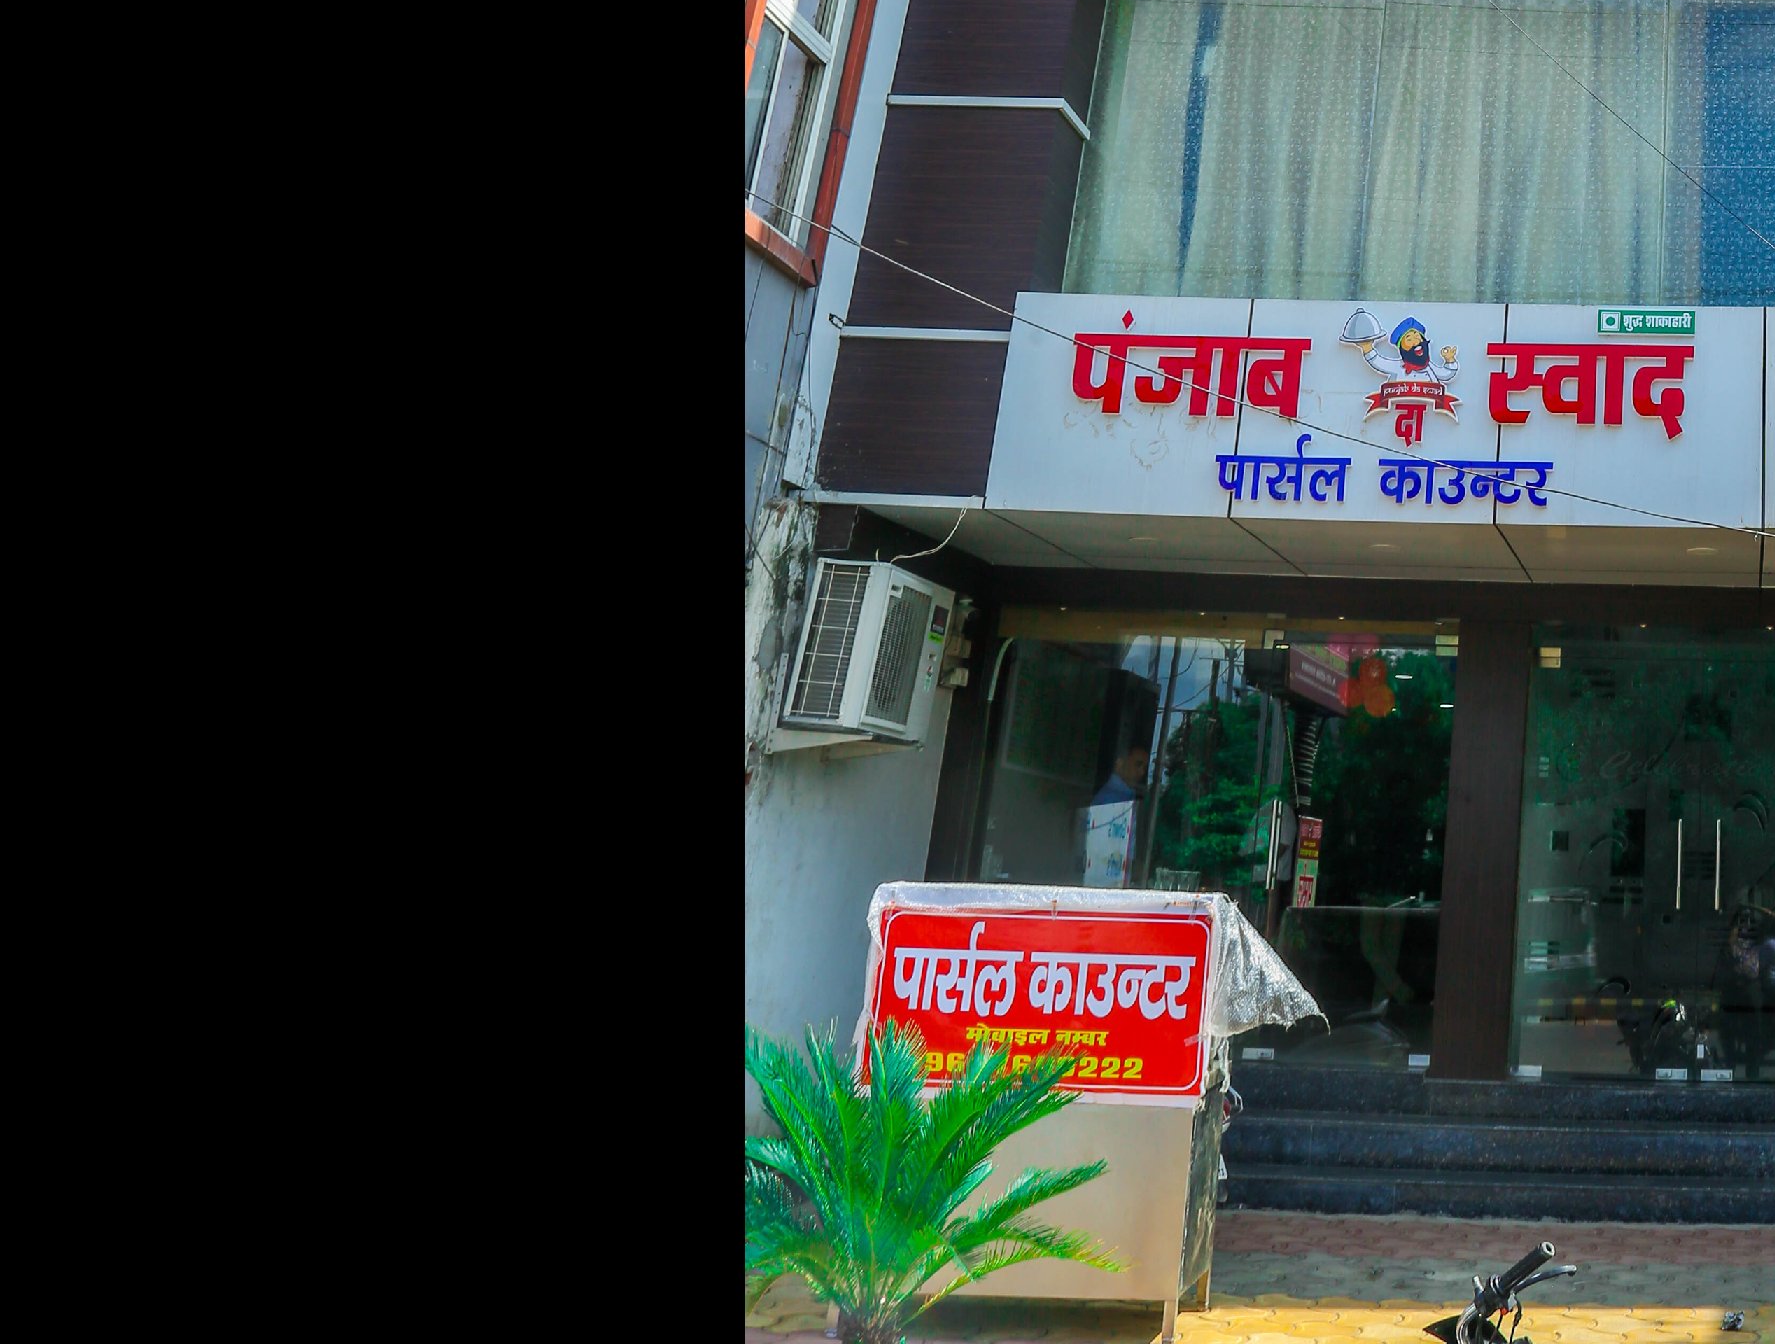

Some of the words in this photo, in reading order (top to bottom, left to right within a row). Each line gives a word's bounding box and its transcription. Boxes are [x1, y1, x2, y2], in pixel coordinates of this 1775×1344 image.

[1072, 308, 1313, 419] पंजाब
[1623, 314, 1644, 332] शुद्ध
[1645, 312, 1693, 328] शाकाहारी
[1394, 403, 1428, 448] दा
[1486, 342, 1695, 441] स्वाद
[1215, 433, 1352, 503] पार्सल
[1378, 458, 1554, 508] काउन्टर
[893, 921, 1025, 1018] पार्सल
[1028, 951, 1197, 1020] काउन्टर
